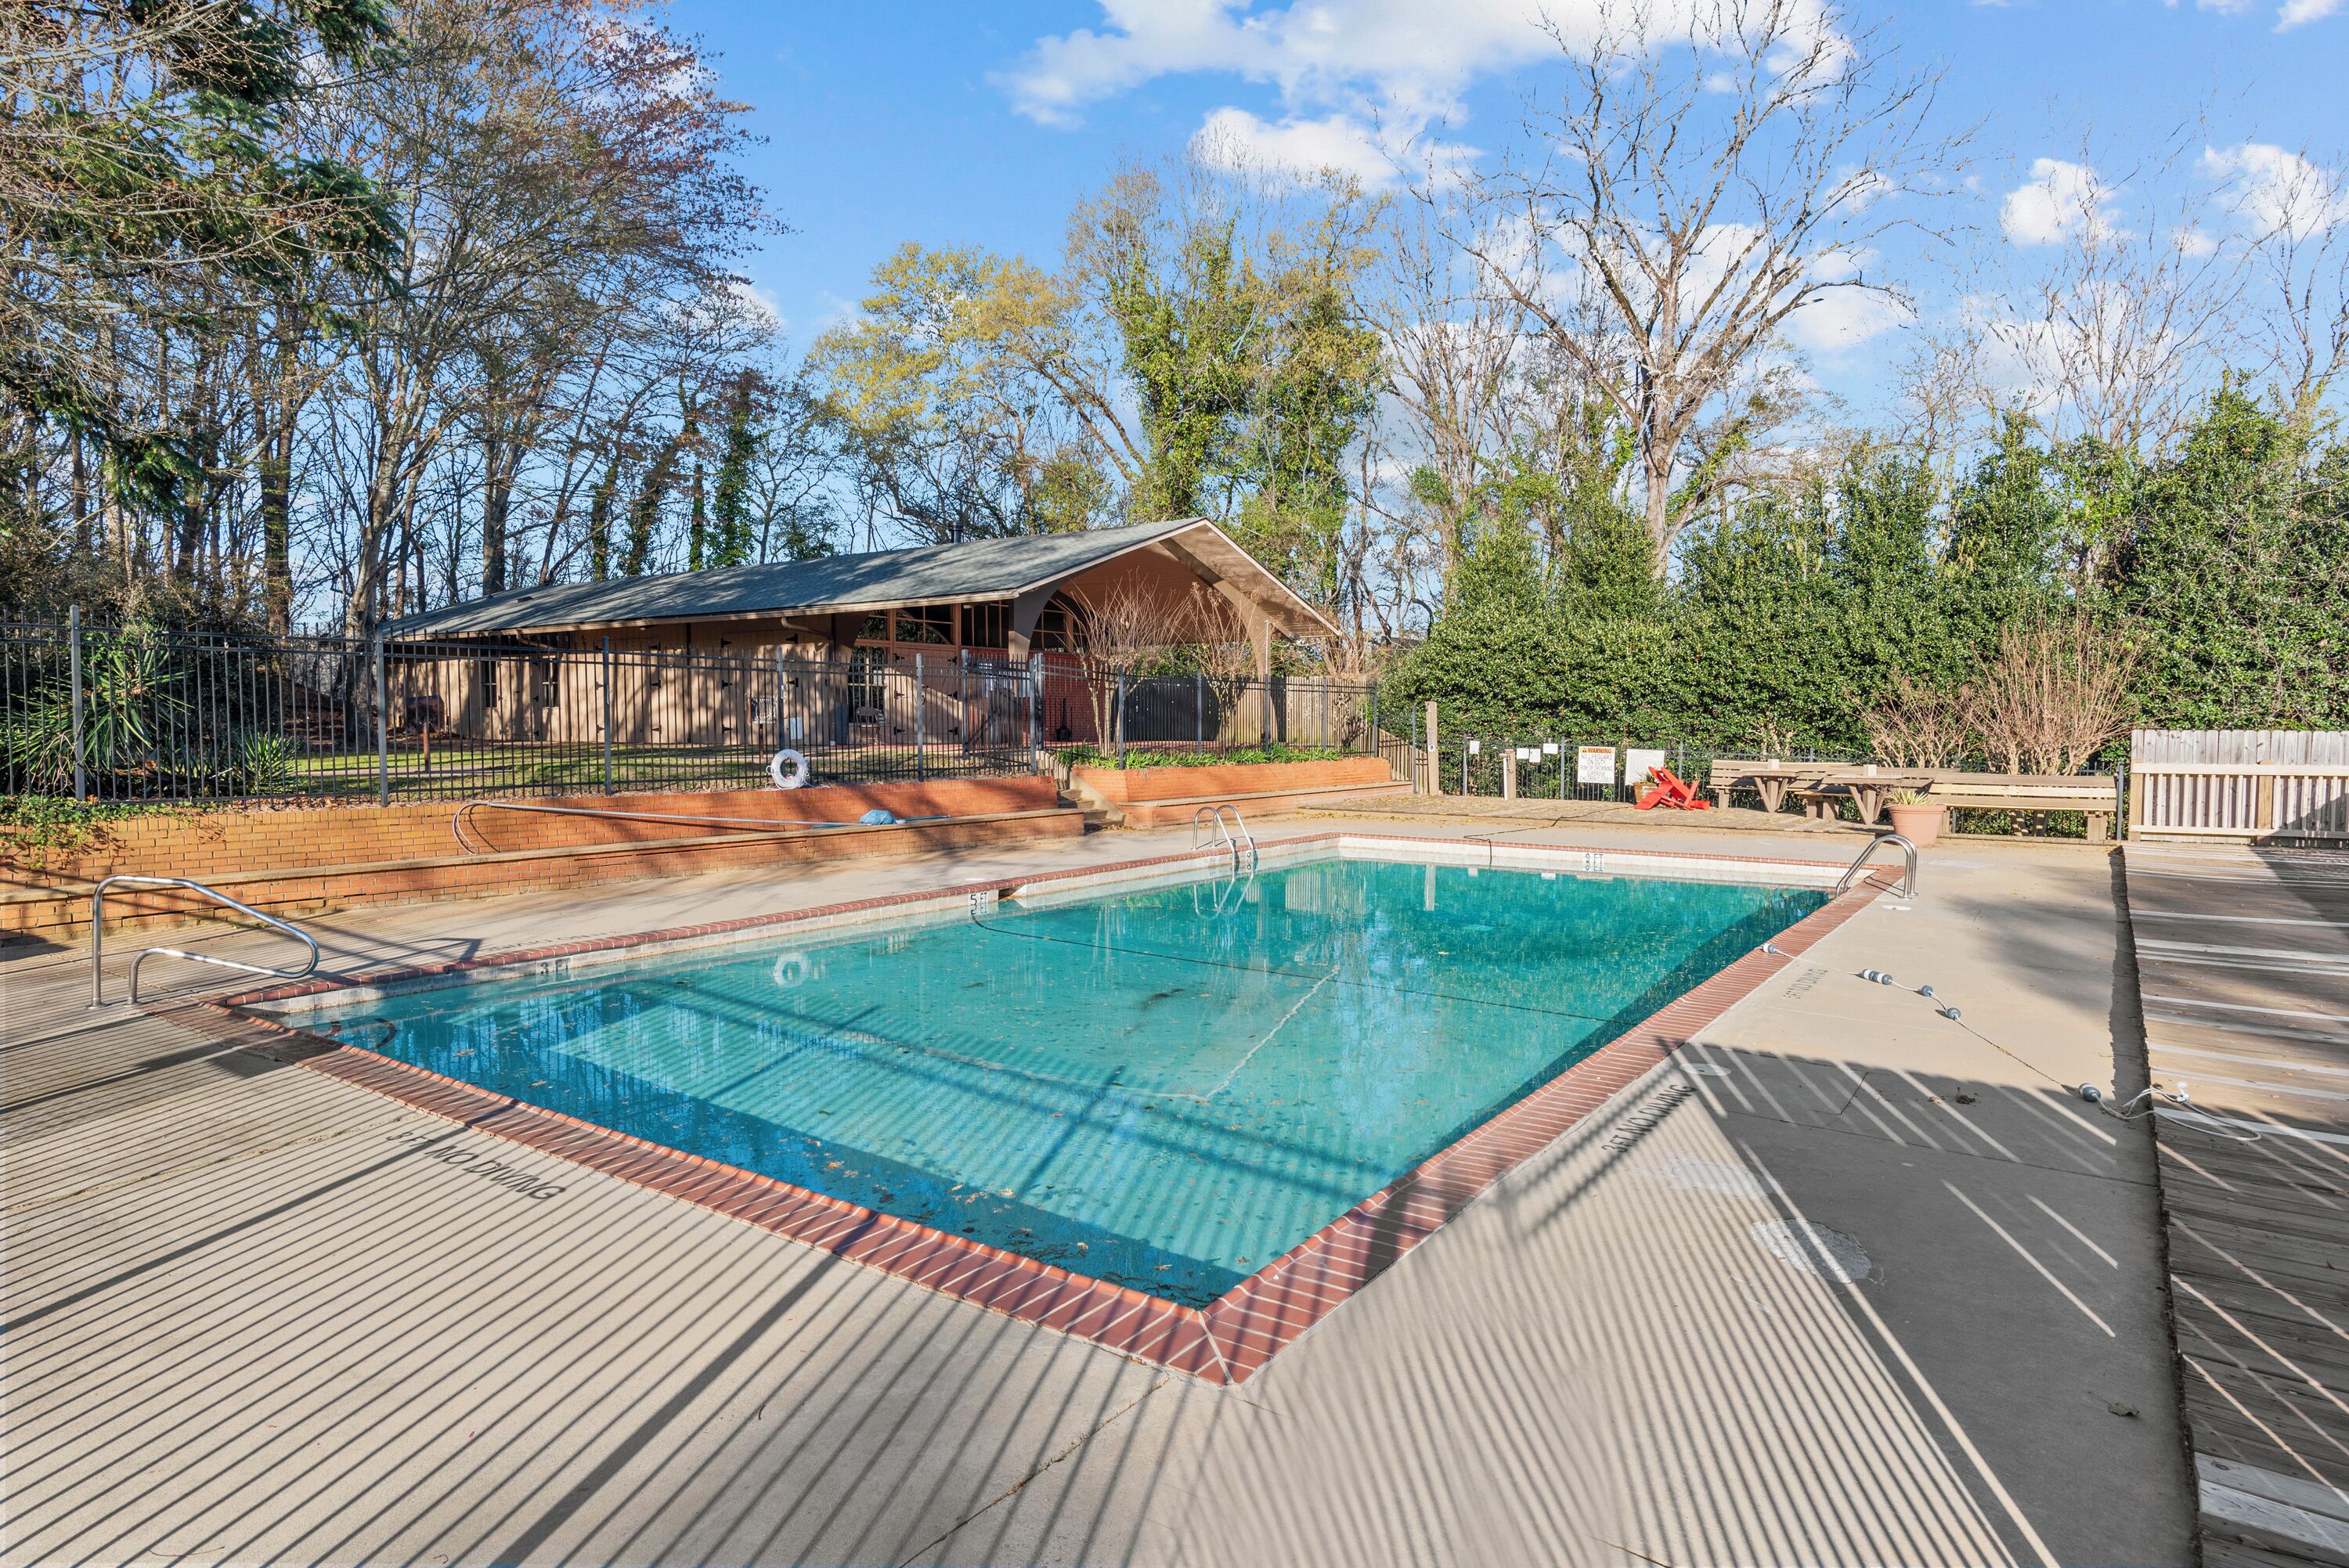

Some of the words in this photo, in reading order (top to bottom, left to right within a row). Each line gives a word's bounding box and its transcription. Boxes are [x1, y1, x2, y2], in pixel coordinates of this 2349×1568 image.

[970, 894, 977, 905] 5
[980, 892, 988, 903] FT
[540, 961, 549, 974] 3
[554, 957, 571, 971] FT
[1615, 1117, 1658, 1136] NO
[1637, 1084, 1698, 1118] DIVING
[424, 1145, 480, 1165] NO
[462, 1159, 567, 1200] DIVING
